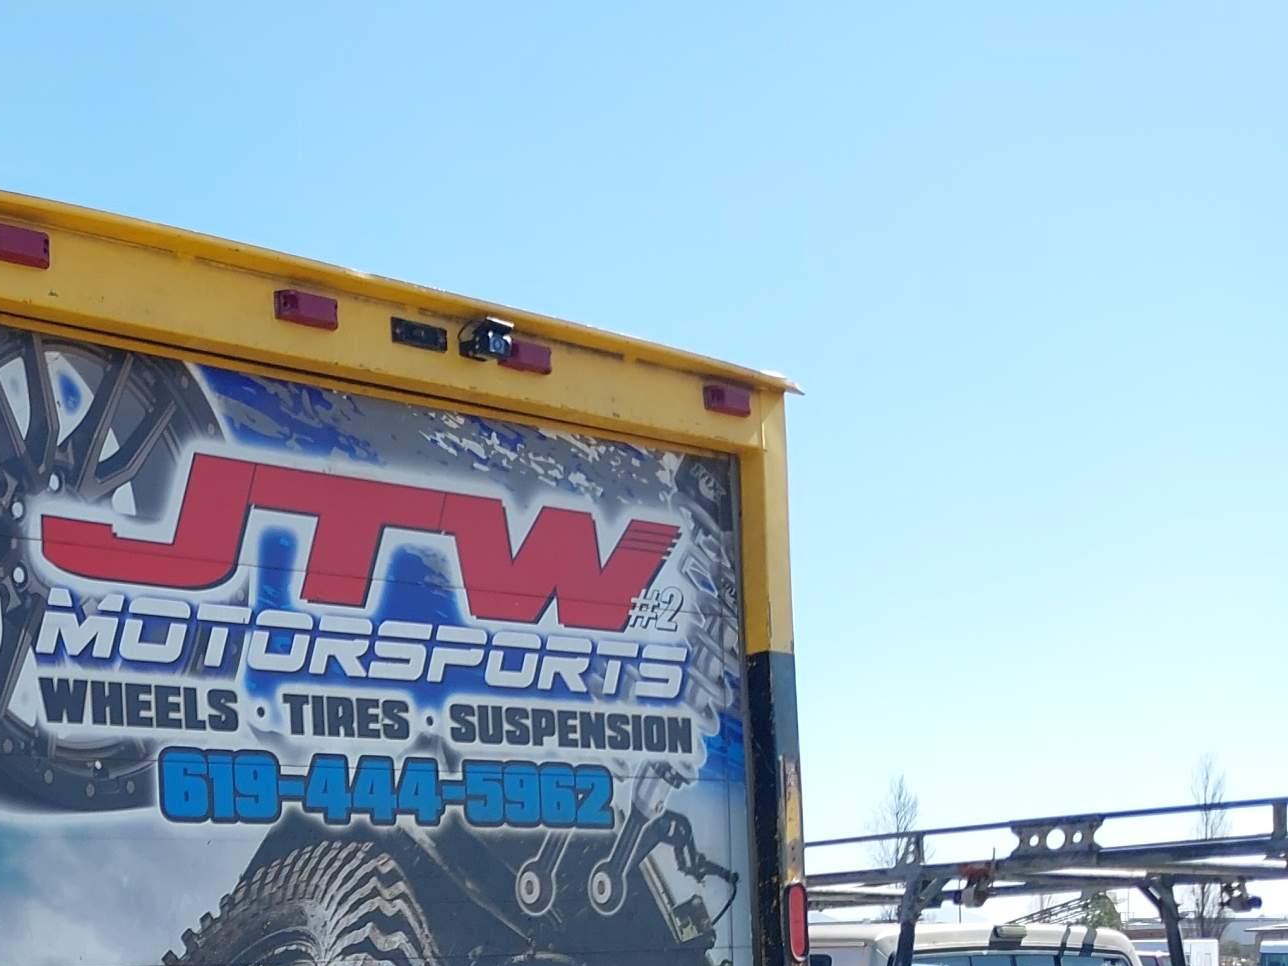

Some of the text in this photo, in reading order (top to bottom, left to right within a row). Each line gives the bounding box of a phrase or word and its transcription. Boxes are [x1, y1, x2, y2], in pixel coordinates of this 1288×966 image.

[40, 452, 684, 632] JTW #2
[35, 588, 690, 699] MOTORSPORTS
[38, 677, 693, 754] WHEELS TIRES SUSPENSION
[159, 746, 615, 829] 619-444-5962
